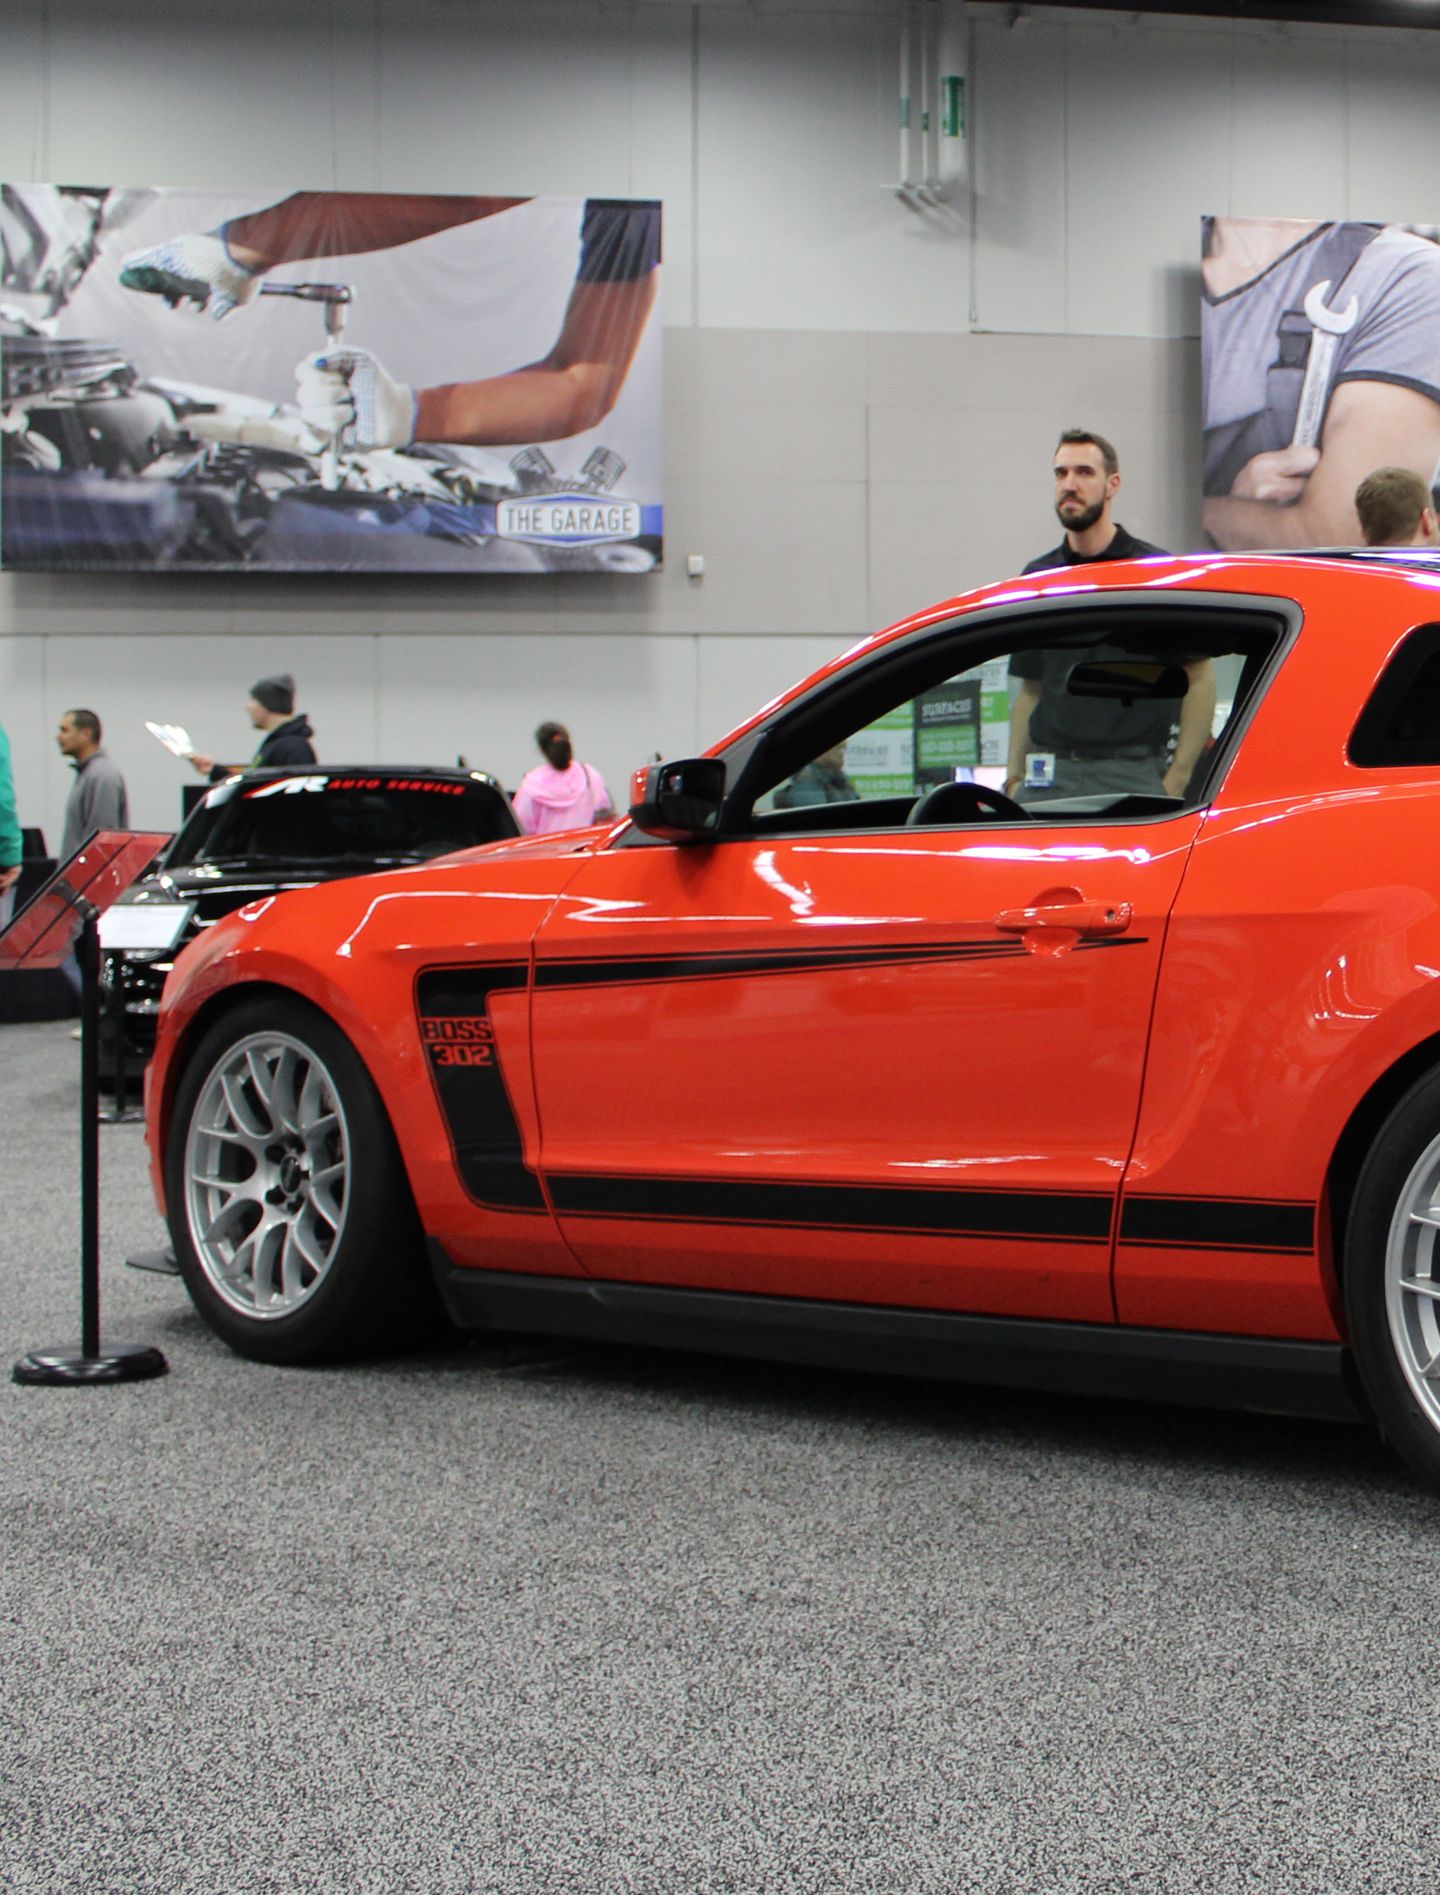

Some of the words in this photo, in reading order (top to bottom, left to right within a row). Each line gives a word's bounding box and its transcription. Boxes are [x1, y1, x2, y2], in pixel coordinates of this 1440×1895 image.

[508, 509, 543, 531] THE
[551, 509, 632, 532] GARAGE
[328, 778, 382, 791] AUTO
[421, 1020, 493, 1040] BOSS
[433, 1045, 494, 1067] 302
